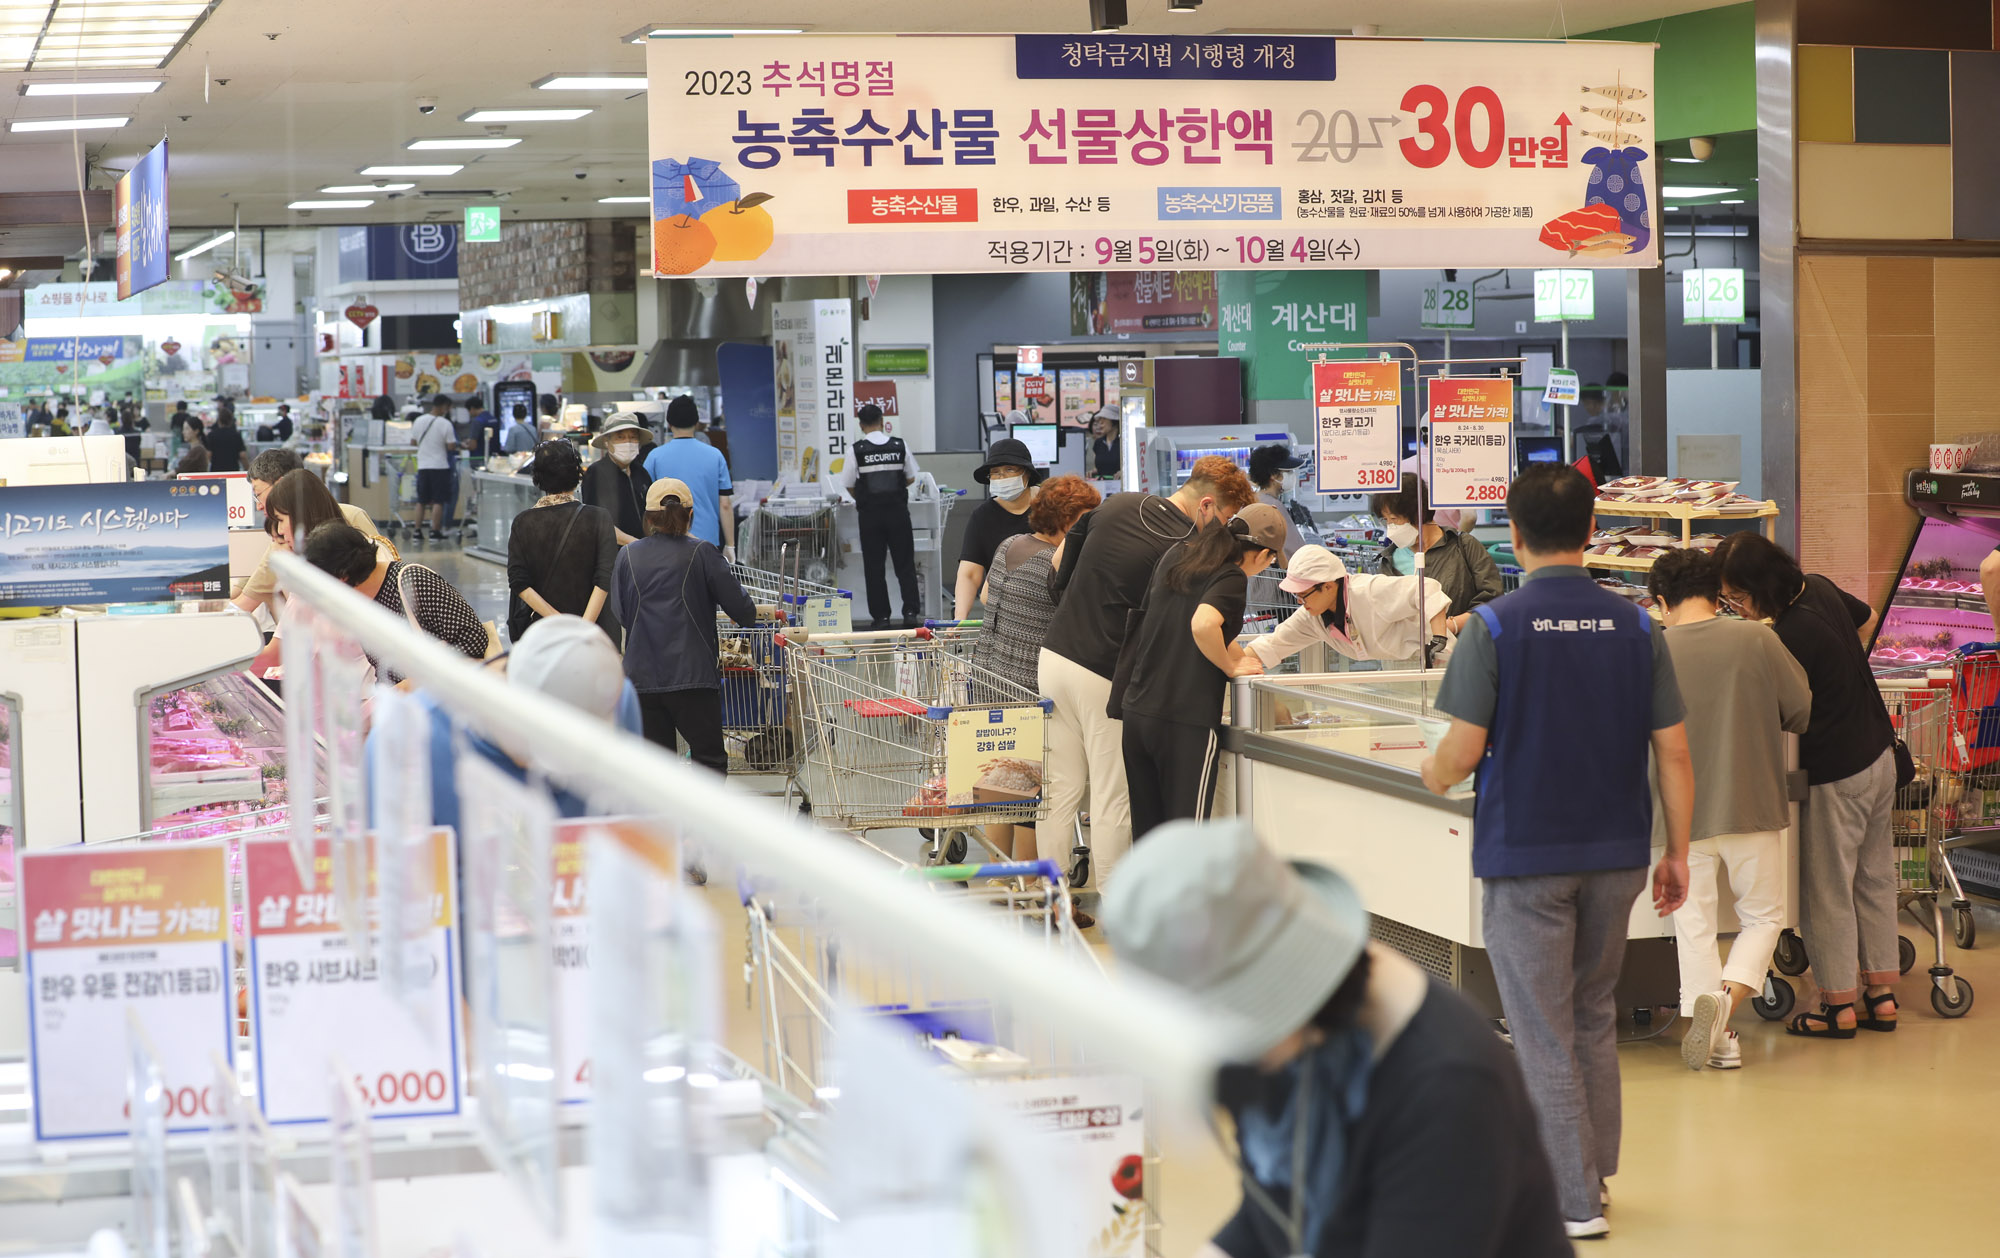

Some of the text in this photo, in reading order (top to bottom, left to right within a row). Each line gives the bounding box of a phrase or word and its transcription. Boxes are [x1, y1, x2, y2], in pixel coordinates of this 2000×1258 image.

[1060, 42, 1297, 69] 청탁금지법 시행령 개정
[684, 60, 895, 97] 2023 추석명절
[732, 108, 1000, 169] 농축수산물
[1018, 107, 1274, 166] 선물상한액
[870, 195, 958, 217] 농축수산물
[992, 195, 1111, 214] 한우, 과일, 수산 등
[1164, 192, 1274, 215] 농축수산가공품
[1298, 189, 1404, 204] 홍삼, 젓갈, 김치 등
[1296, 206, 1346, 219] (농수산물을
[1427, 206, 1446, 218] 넘게
[1447, 206, 1483, 218] 사용하여
[1484, 206, 1512, 218] 가공한
[1512, 206, 1534, 218] 제품)
[1094, 236, 1133, 265] 9월
[1138, 236, 1210, 264] 5일(화)
[1235, 236, 1286, 264] 10월
[1289, 236, 1361, 264] 4일(수)
[1423, 288, 1437, 310] 28
[1441, 288, 1469, 311] 28
[1538, 278, 1557, 301] 27
[1564, 277, 1589, 300] 27
[1685, 277, 1701, 302] 26
[1708, 277, 1738, 301] 26
[1222, 302, 1252, 332] 계산대
[1271, 302, 1357, 332] 계산대
[1227, 340, 1247, 352] Counter
[1025, 380, 1044, 388] CCTV
[1319, 387, 1396, 402] 살 맛나는 가격!
[825, 344, 848, 455] 레몬라테라
[1434, 404, 1509, 418] 살 맛나는 가격!
[1321, 416, 1374, 429] 한우 불고기
[1434, 435, 1506, 447] 한우 국거리(1등급)
[864, 452, 901, 463] SECURITY
[1357, 469, 1395, 486] 3,180
[1465, 485, 1507, 502] 2,880
[80, 505, 190, 536] 시스템이다
[1532, 617, 1616, 633] 하나로마트
[976, 740, 1016, 753] 강화 섬쌀
[258, 893, 292, 930] 살
[33, 904, 221, 943] 살 맛나는 가격!
[265, 961, 301, 988] 한우
[40, 974, 77, 1004] 한우
